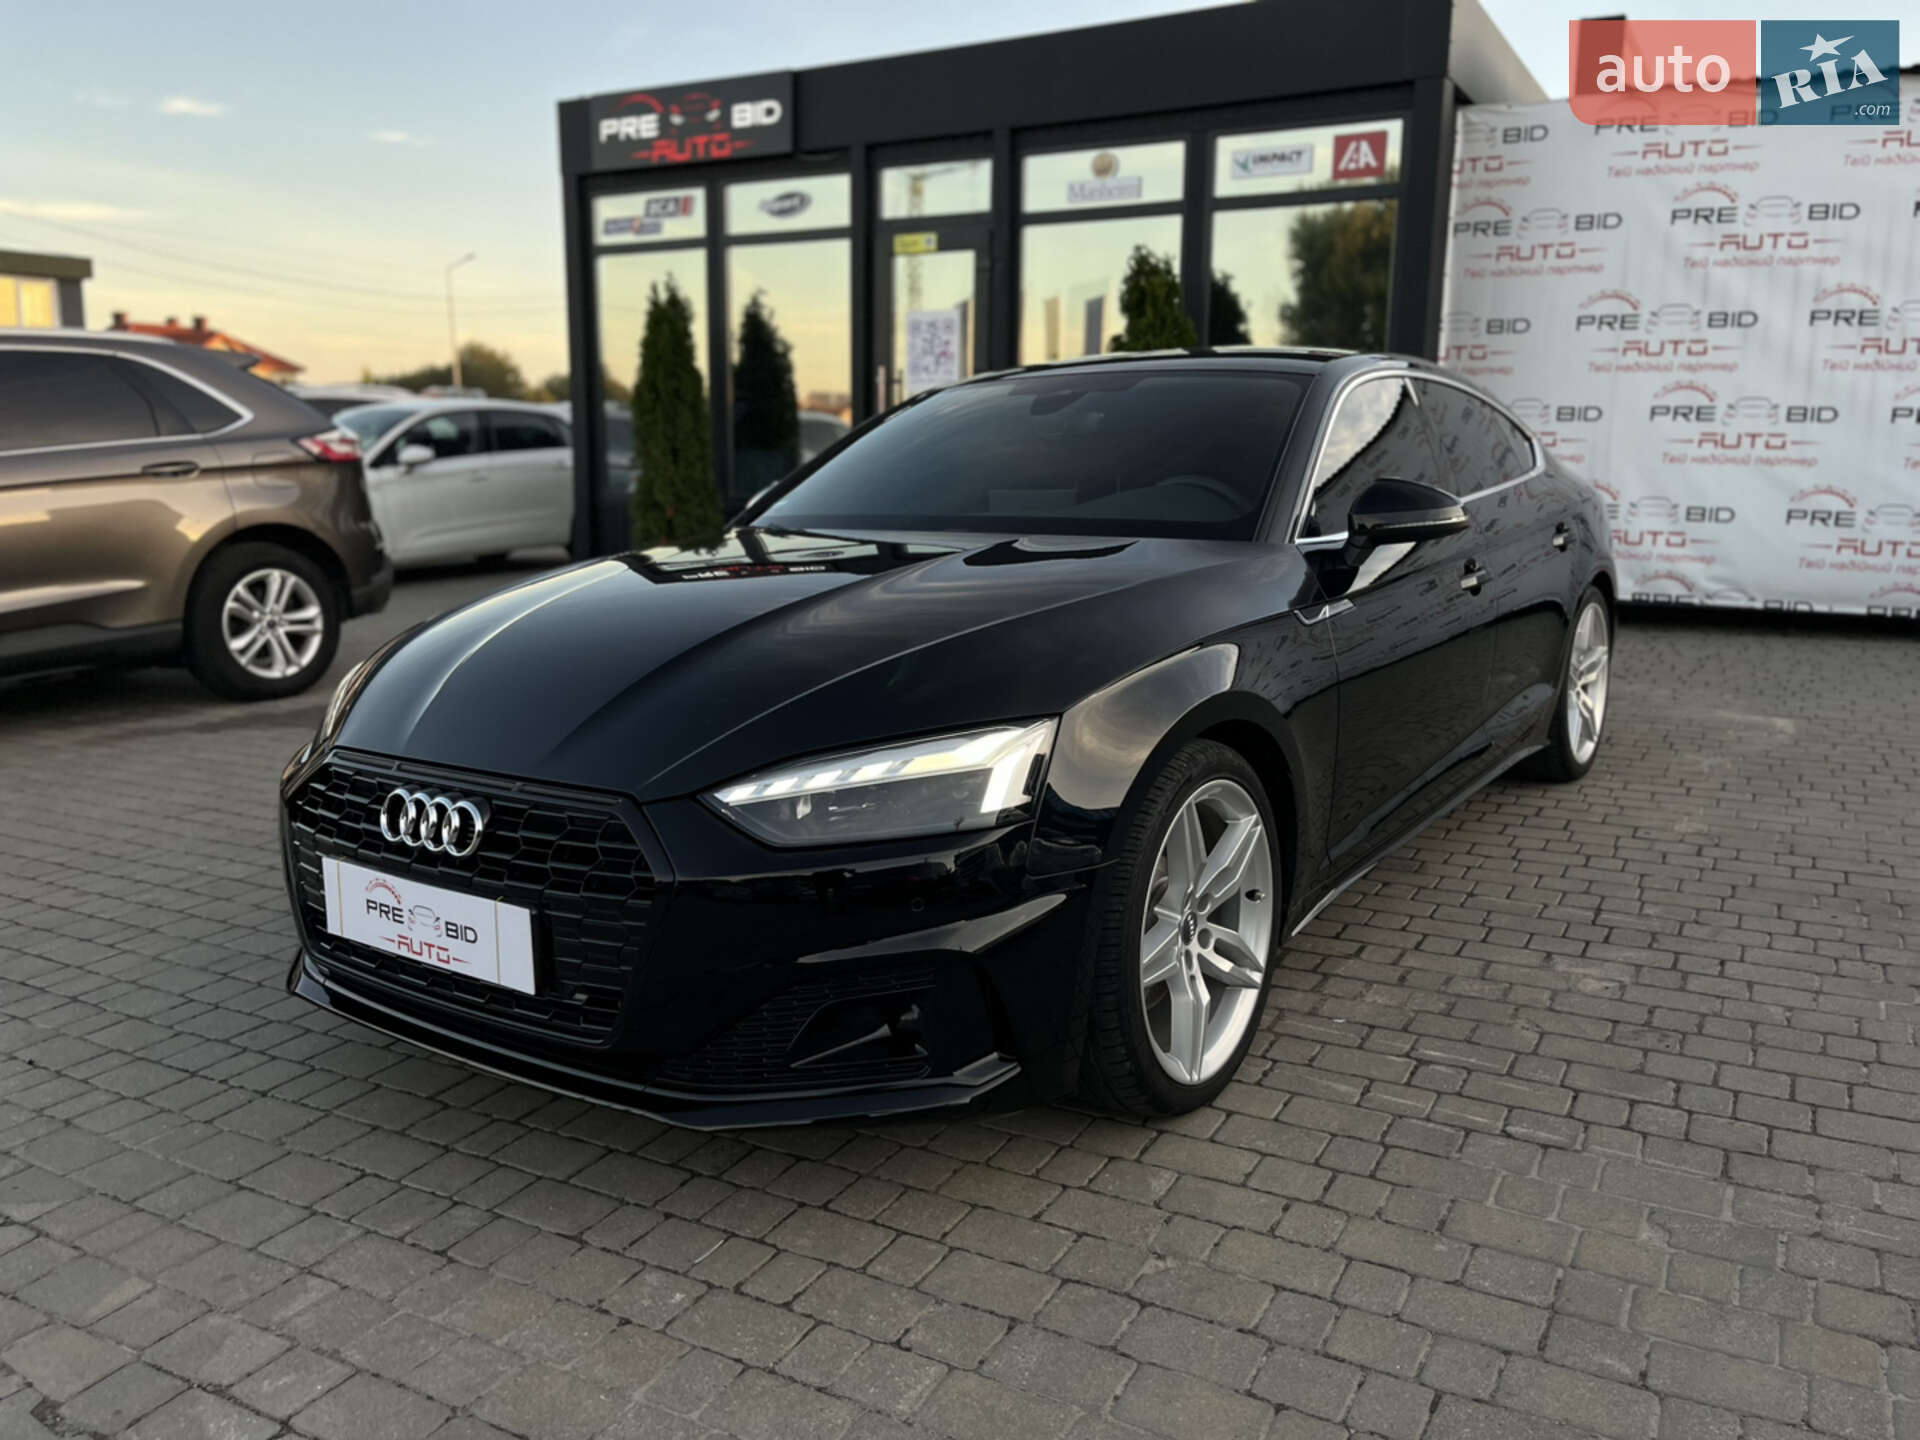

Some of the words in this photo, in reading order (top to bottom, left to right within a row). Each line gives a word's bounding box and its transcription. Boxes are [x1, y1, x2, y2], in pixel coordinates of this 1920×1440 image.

[599, 113, 660, 144] PRE
[731, 99, 782, 129] BID
[1503, 125, 1549, 144] BID
[652, 132, 733, 164] AUTO
[1642, 139, 1729, 160] AUTO
[1671, 206, 1738, 225] PRE
[1807, 203, 1861, 221] BID
[1453, 219, 1512, 239] PRE
[1574, 212, 1623, 232] BID
[1495, 241, 1576, 262] AUTO
[1719, 231, 1809, 252] AUTO
[1485, 317, 1531, 335] BID
[1576, 313, 1641, 332] PRE
[1707, 310, 1759, 329] BID
[1809, 309, 1881, 327] PRE
[1622, 338, 1709, 357] AUTO
[1556, 405, 1603, 423] BID
[1649, 405, 1716, 423] PRE
[1786, 405, 1839, 424] BID
[1697, 432, 1787, 451] AUTO
[1685, 506, 1736, 524] BID
[1785, 508, 1857, 528] PRE
[366, 898, 404, 925] PRE
[445, 921, 478, 944] BID
[397, 933, 451, 965] AUTO
